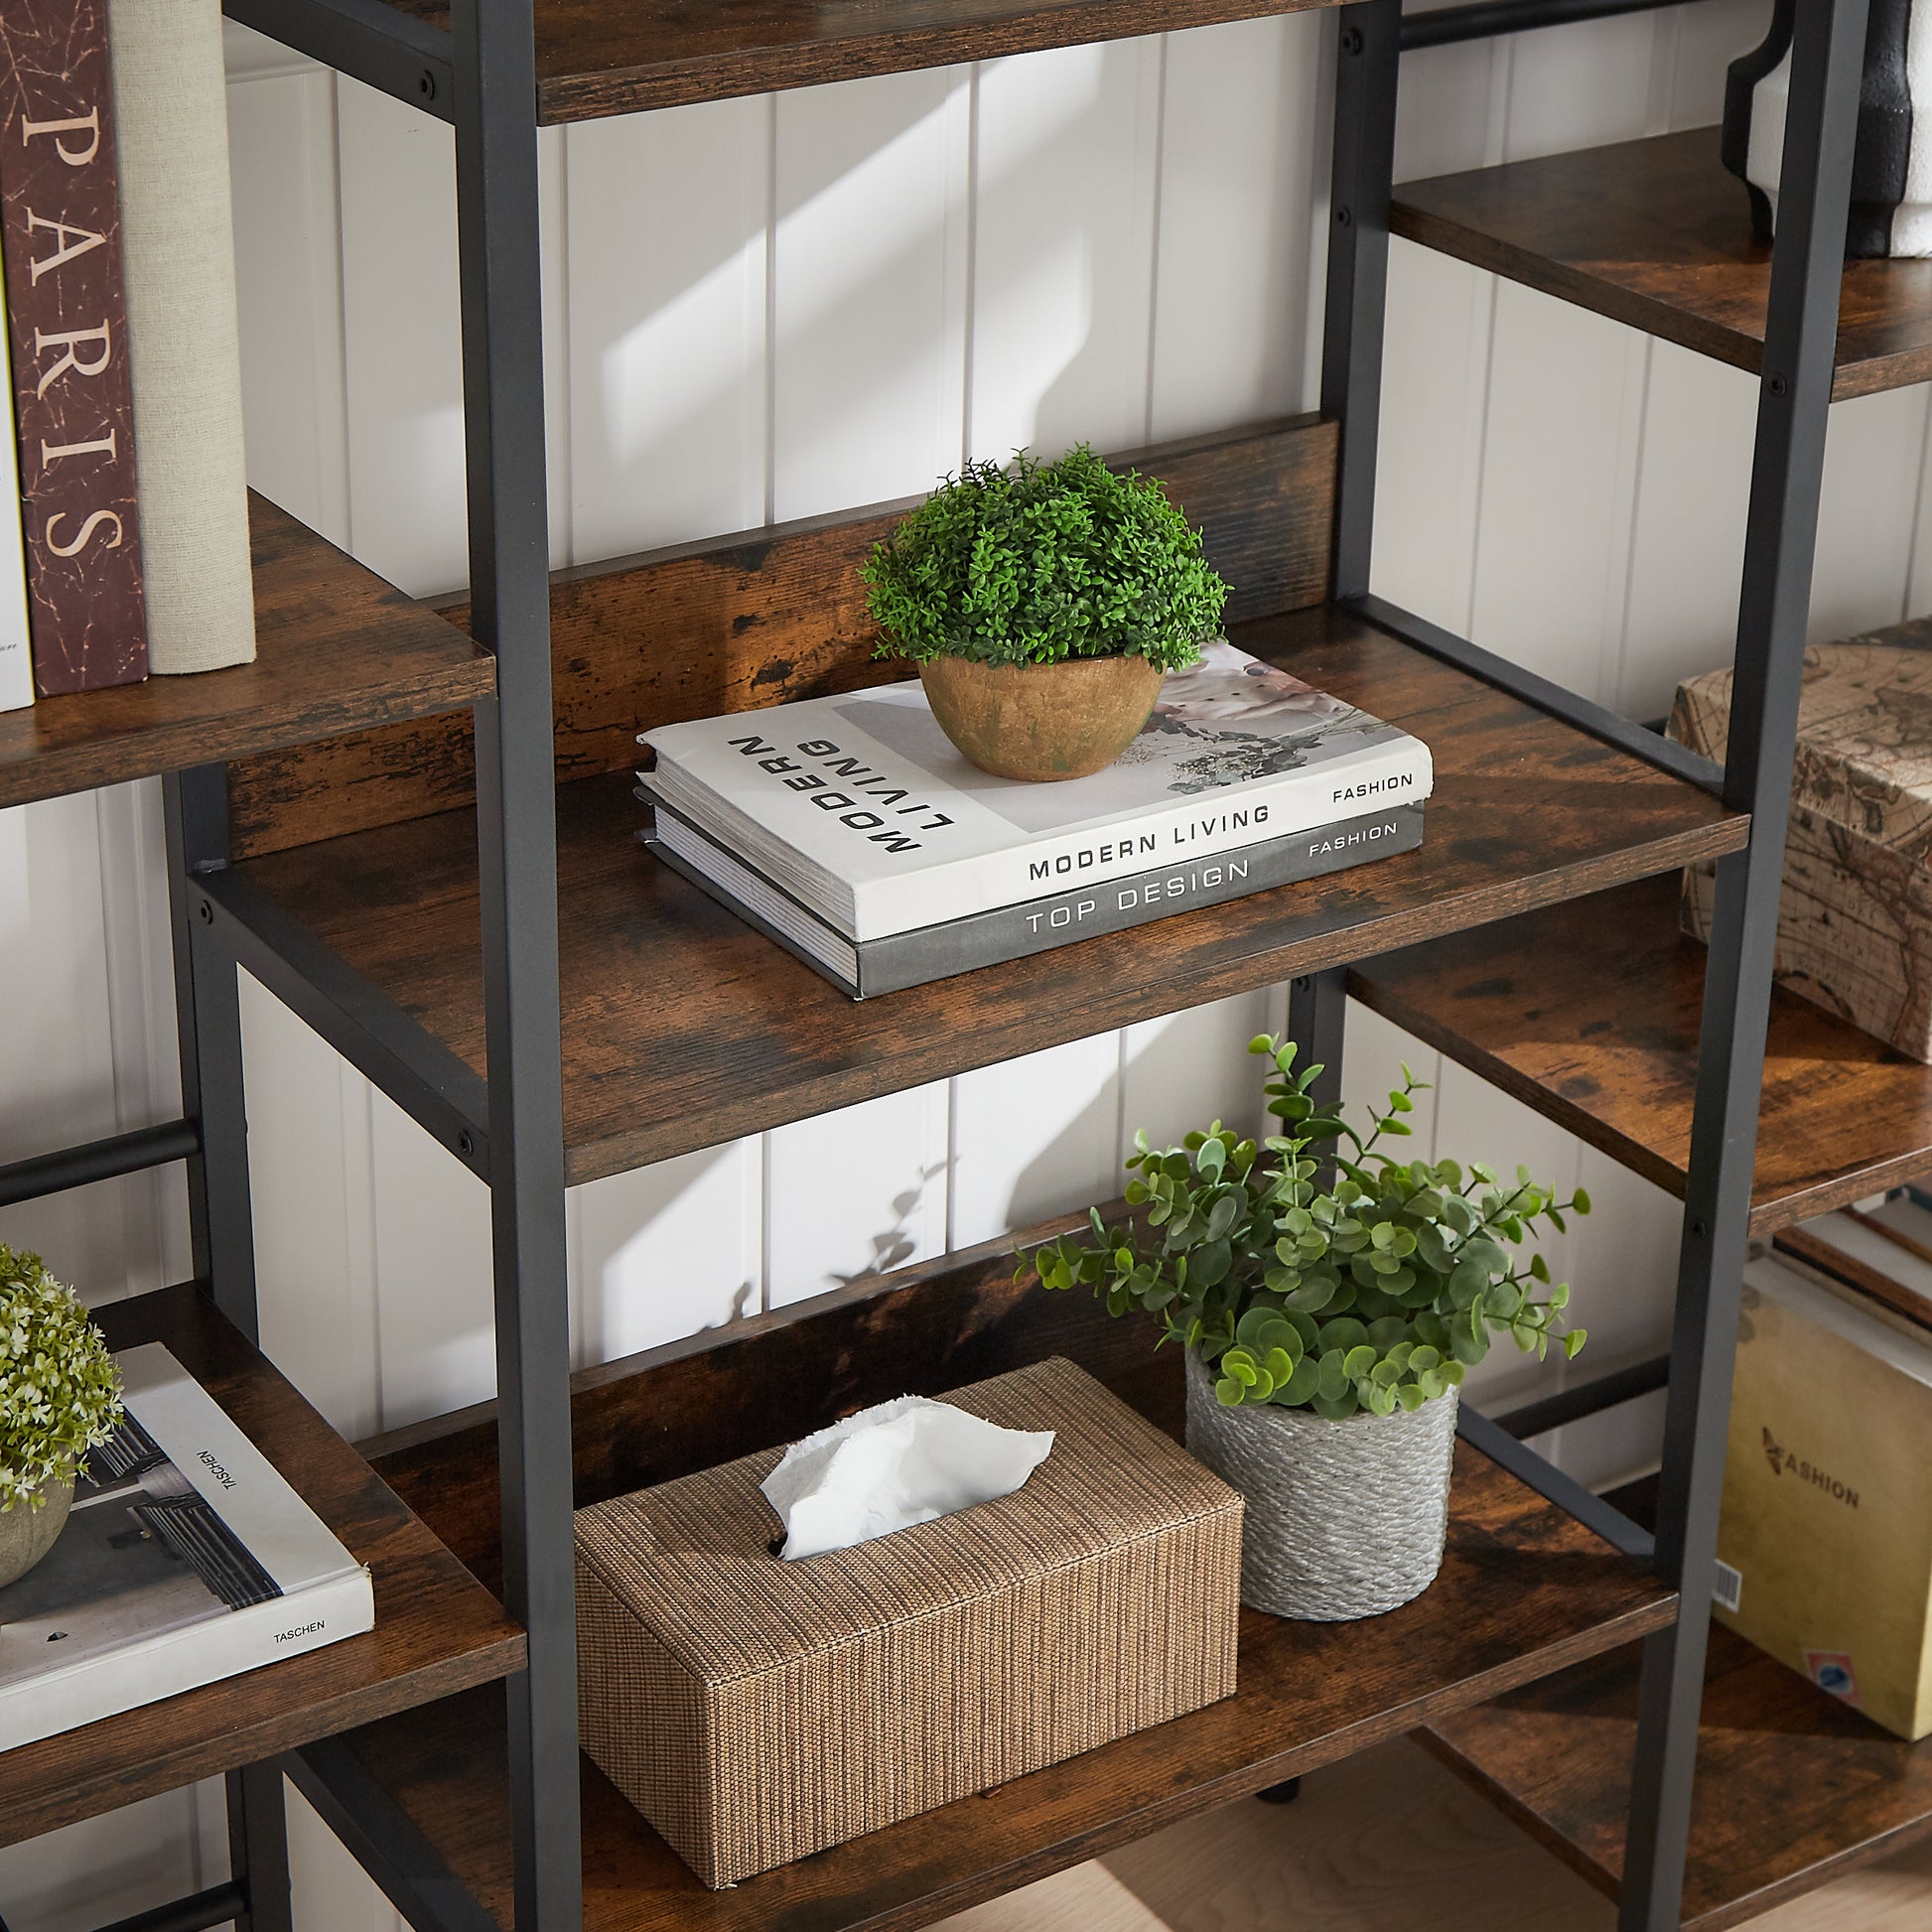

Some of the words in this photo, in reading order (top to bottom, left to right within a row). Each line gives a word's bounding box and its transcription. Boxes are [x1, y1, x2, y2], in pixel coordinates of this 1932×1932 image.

[21, 105, 123, 558] PARIS
[728, 736, 923, 854] MODERN
[797, 740, 955, 830] LIVING
[1332, 773, 1413, 803] FASHION
[1029, 833, 1157, 881] MODERN
[1174, 805, 1269, 844] LIVING
[1309, 823, 1398, 857] FASHION
[1026, 899, 1095, 933] TOP
[1118, 860, 1250, 911] DESIGN
[197, 1449, 237, 1490] TASCHEN
[273, 1620, 326, 1644] TASCHEN
